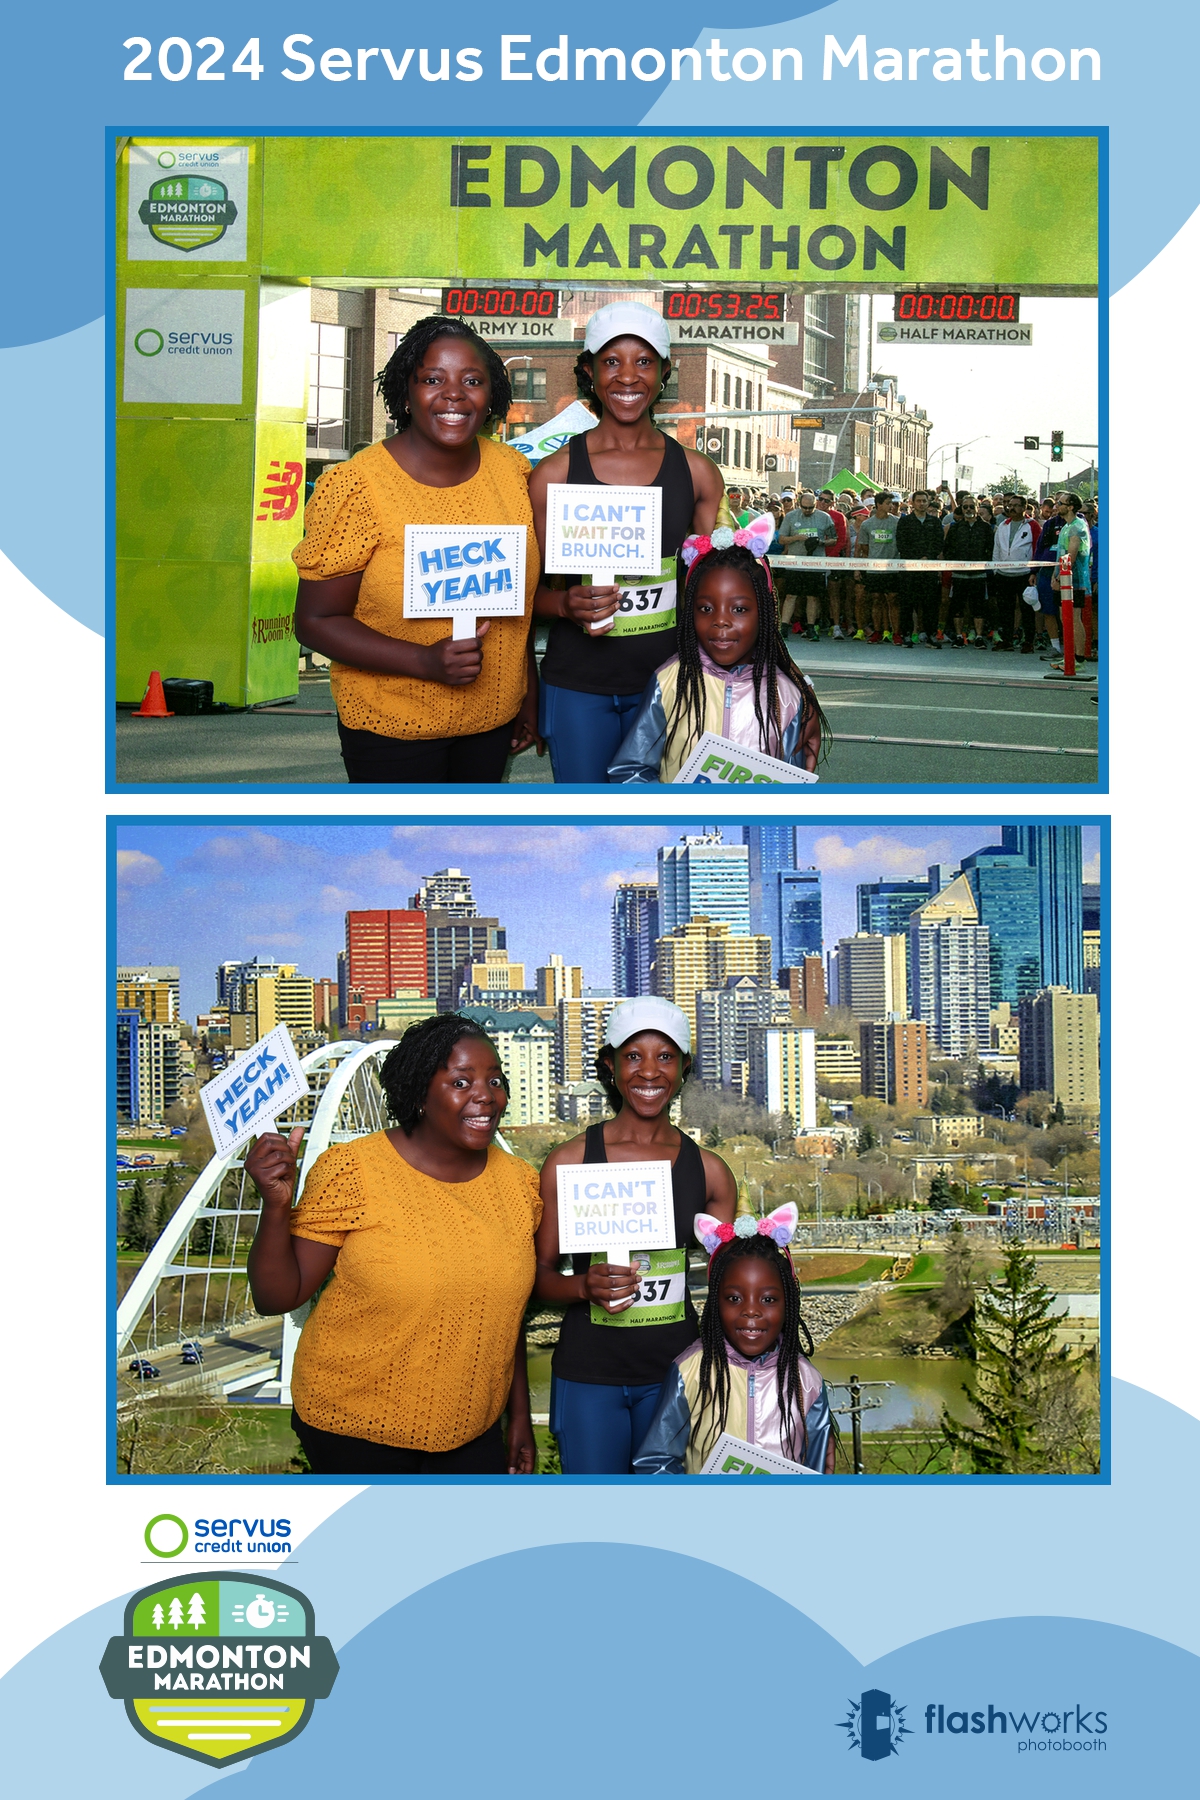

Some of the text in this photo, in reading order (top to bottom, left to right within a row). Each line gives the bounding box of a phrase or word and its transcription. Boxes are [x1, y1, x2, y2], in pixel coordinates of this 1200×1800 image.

[178, 152, 220, 160] servus
[450, 144, 990, 209] EDMONTON
[149, 203, 227, 214] EDMONTON
[160, 214, 216, 222] MARATHON
[523, 223, 907, 271] MARATHON
[469, 321, 554, 336] ARMY 10K
[678, 325, 785, 340] MARATHON
[900, 327, 1031, 341] HALF MARATHON
[168, 331, 234, 345] servus
[168, 345, 233, 356] credit union
[562, 504, 646, 523] I CAN'T
[561, 525, 646, 541] WAIT FOR
[418, 538, 506, 575] HECK
[561, 542, 645, 559] BRUNCH.
[422, 567, 513, 606] YEAH!
[638, 623, 668, 632] MARATHON
[701, 754, 782, 783] FIRS
[214, 1045, 277, 1118] HECK
[224, 1063, 291, 1137] YEAH!
[573, 1180, 656, 1200] I CAN'T
[573, 1201, 658, 1218] WAIT FOR
[574, 1218, 659, 1236] BRUNCH.
[645, 1315, 677, 1323] MARATHON
